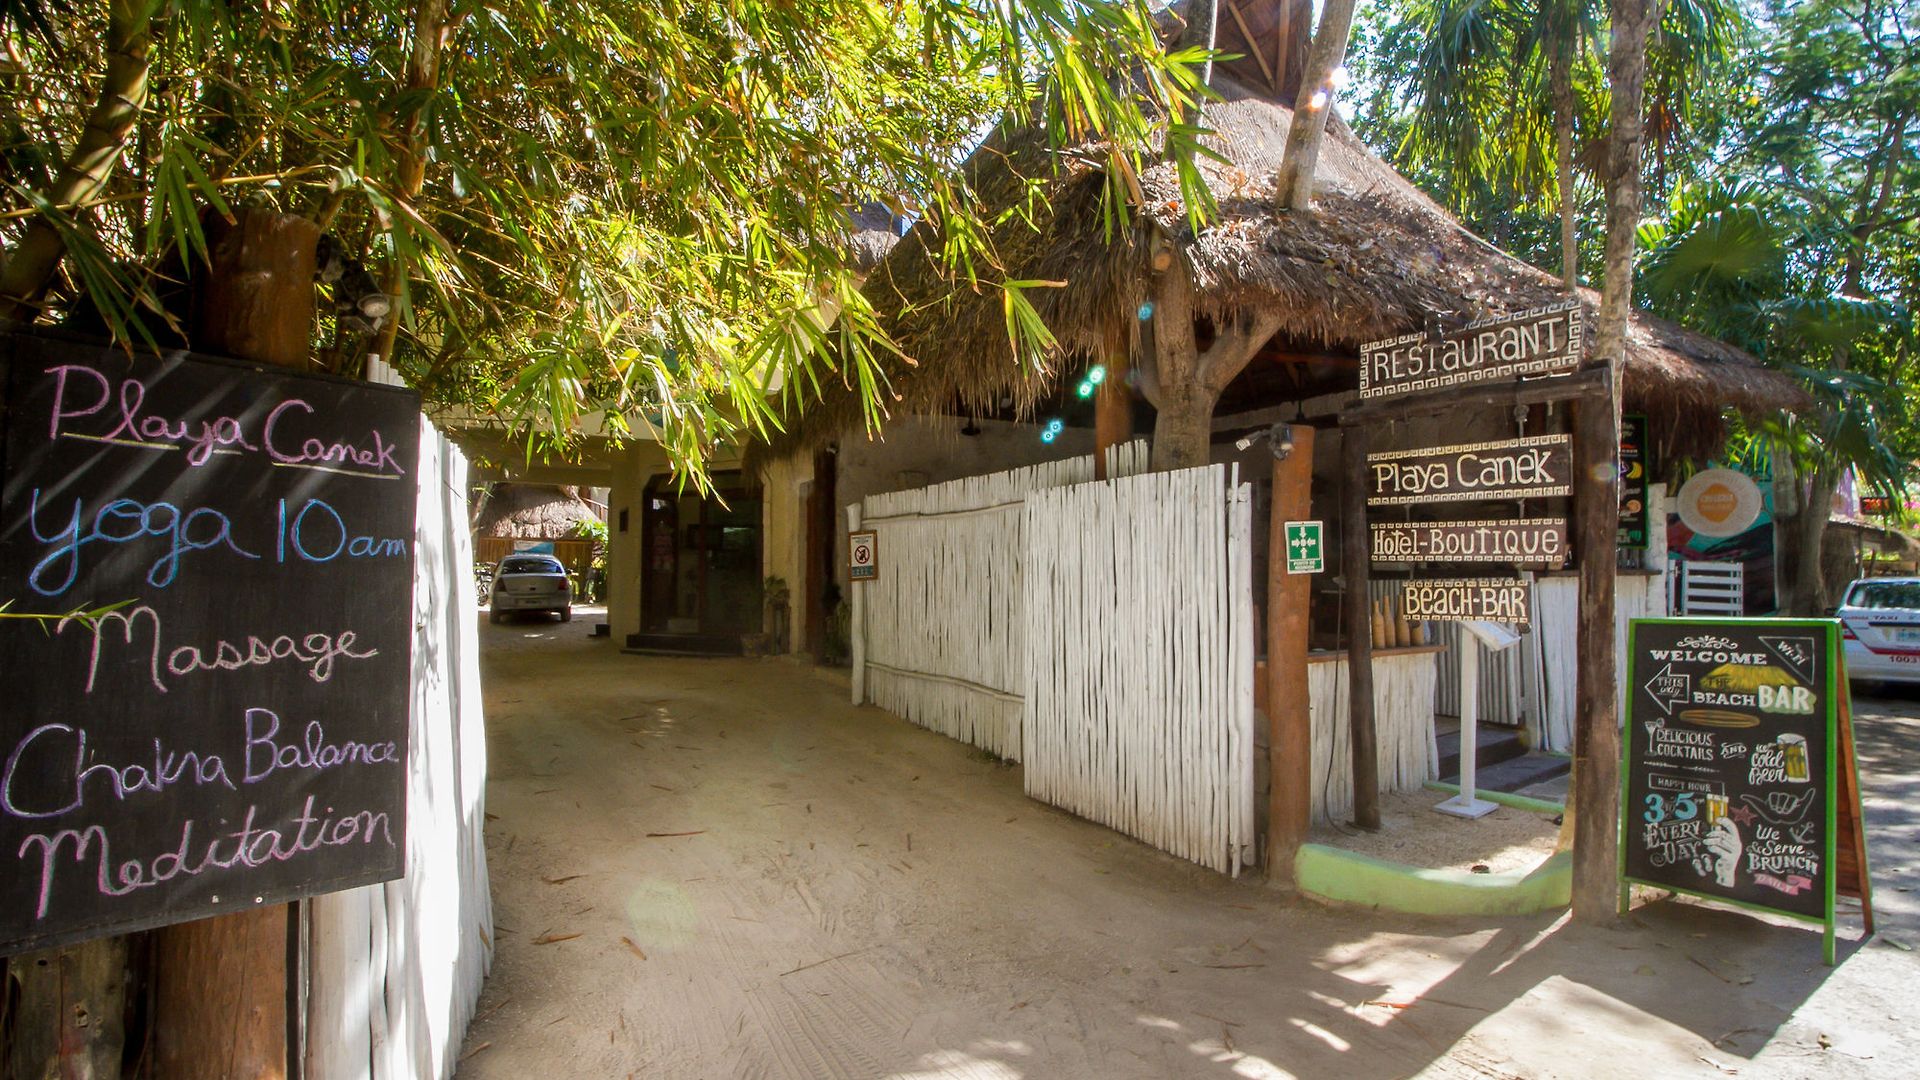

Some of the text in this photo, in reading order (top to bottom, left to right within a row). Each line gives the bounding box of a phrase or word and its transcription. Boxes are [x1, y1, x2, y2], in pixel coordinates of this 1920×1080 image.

[45, 365, 405, 474] Playa Canek
[1372, 449, 1555, 493] Playa Canek
[29, 489, 261, 596] Yoga
[57, 606, 379, 693] Massage
[1650, 650, 1768, 665] WELCOME
[1658, 677, 1684, 688] THIS
[1693, 684, 1812, 713] BEACH BAR
[1656, 728, 1714, 747] DELICIOUS
[1657, 743, 1714, 761] COCKTAILS
[1, 708, 399, 818] Chakra Balance
[1658, 777, 1712, 793] HAPPY HOUR
[1643, 793, 1665, 823] 3
[1674, 791, 1698, 820] 5
[1644, 820, 1702, 850] EVERY
[1756, 824, 1780, 840] We
[18, 795, 396, 920] Meditation
[1762, 839, 1806, 857] Serve
[1747, 852, 1818, 876] BRUNCH
